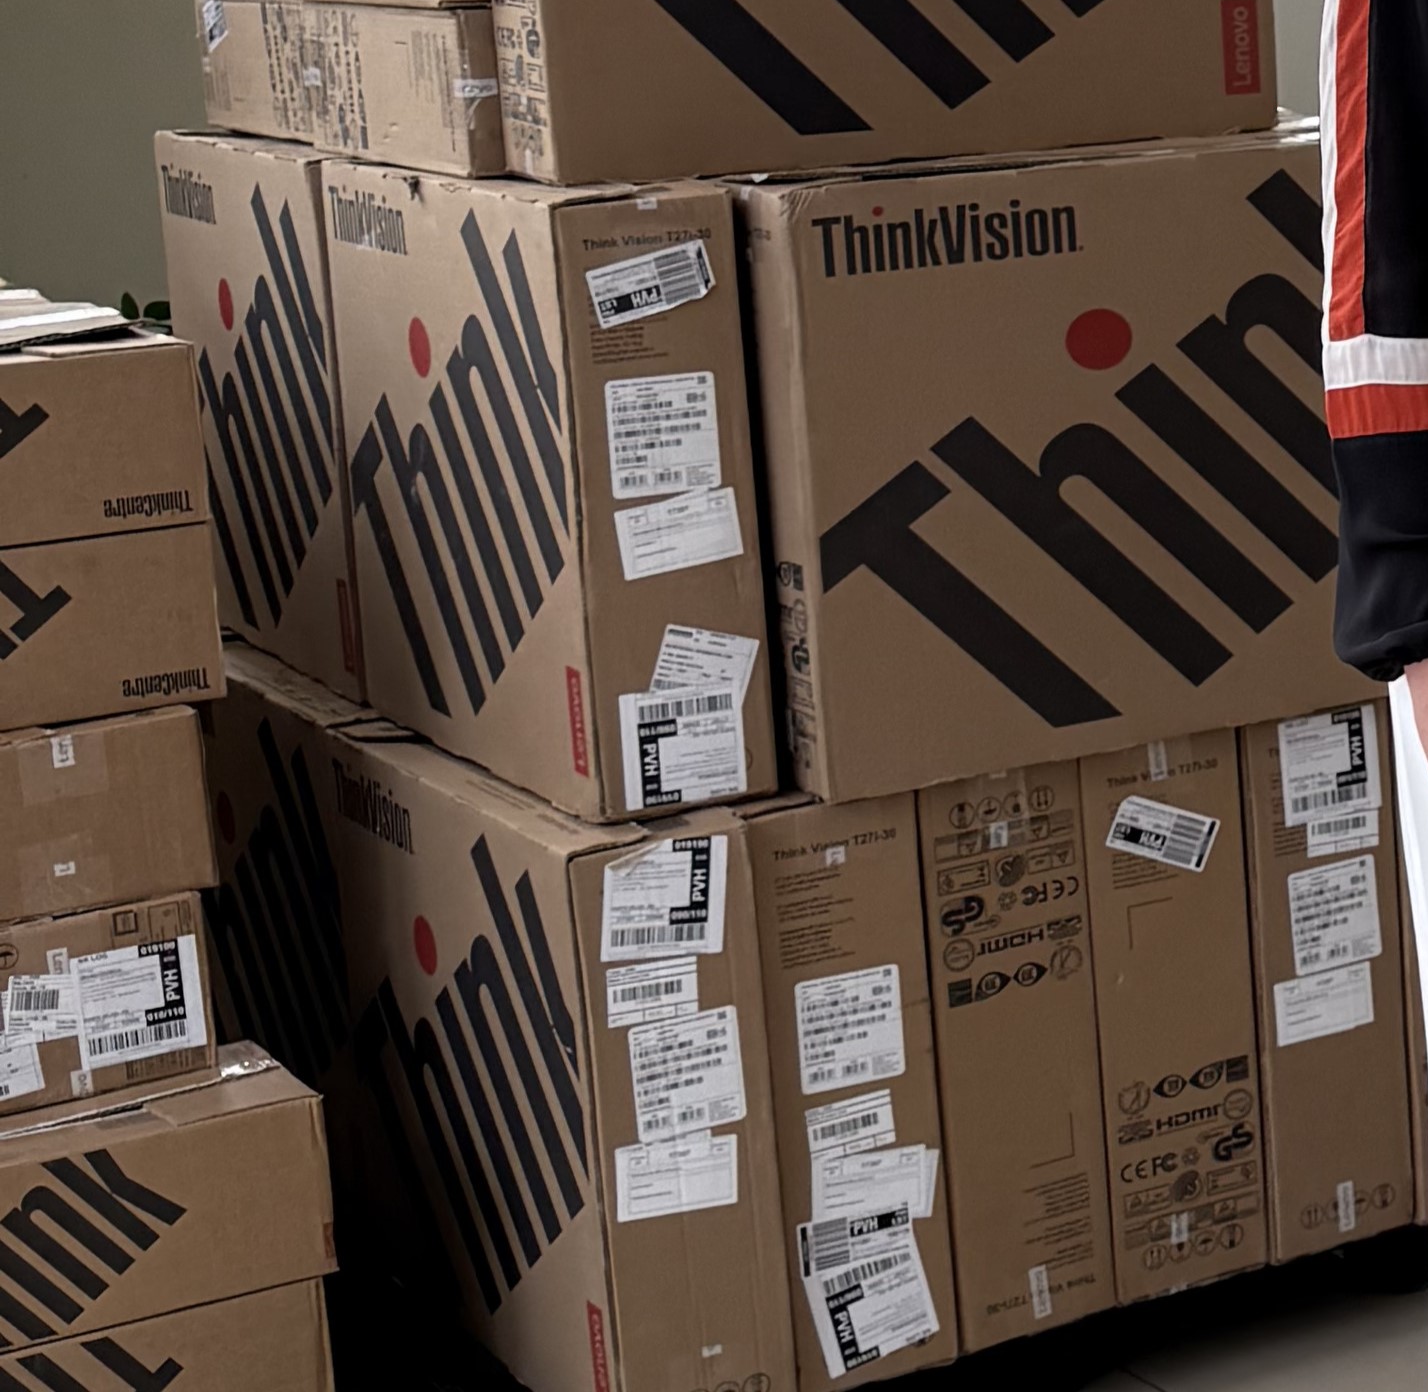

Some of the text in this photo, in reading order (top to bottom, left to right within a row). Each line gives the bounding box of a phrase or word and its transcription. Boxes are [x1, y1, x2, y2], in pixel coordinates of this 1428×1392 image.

[1233, 7, 1252, 86] Lenovo
[161, 163, 217, 225] ThinkVision
[328, 185, 408, 256] ThinkVision
[583, 236, 619, 251] Think
[622, 234, 662, 247] Vision
[811, 200, 1080, 277] ThinkVision
[631, 287, 660, 308] PVH
[351, 207, 571, 718] Think
[819, 169, 1341, 728] Thin
[103, 489, 193, 517] ThinkCentre
[122, 666, 210, 697] ThinkCentre
[643, 744, 657, 777] PVH
[332, 758, 415, 855] ThinkVision
[773, 845, 807, 861] Think
[692, 869, 707, 902] PVH
[166, 969, 181, 1001] PVH
[854, 1216, 878, 1236] PVH
[834, 1310, 854, 1344] PVH
